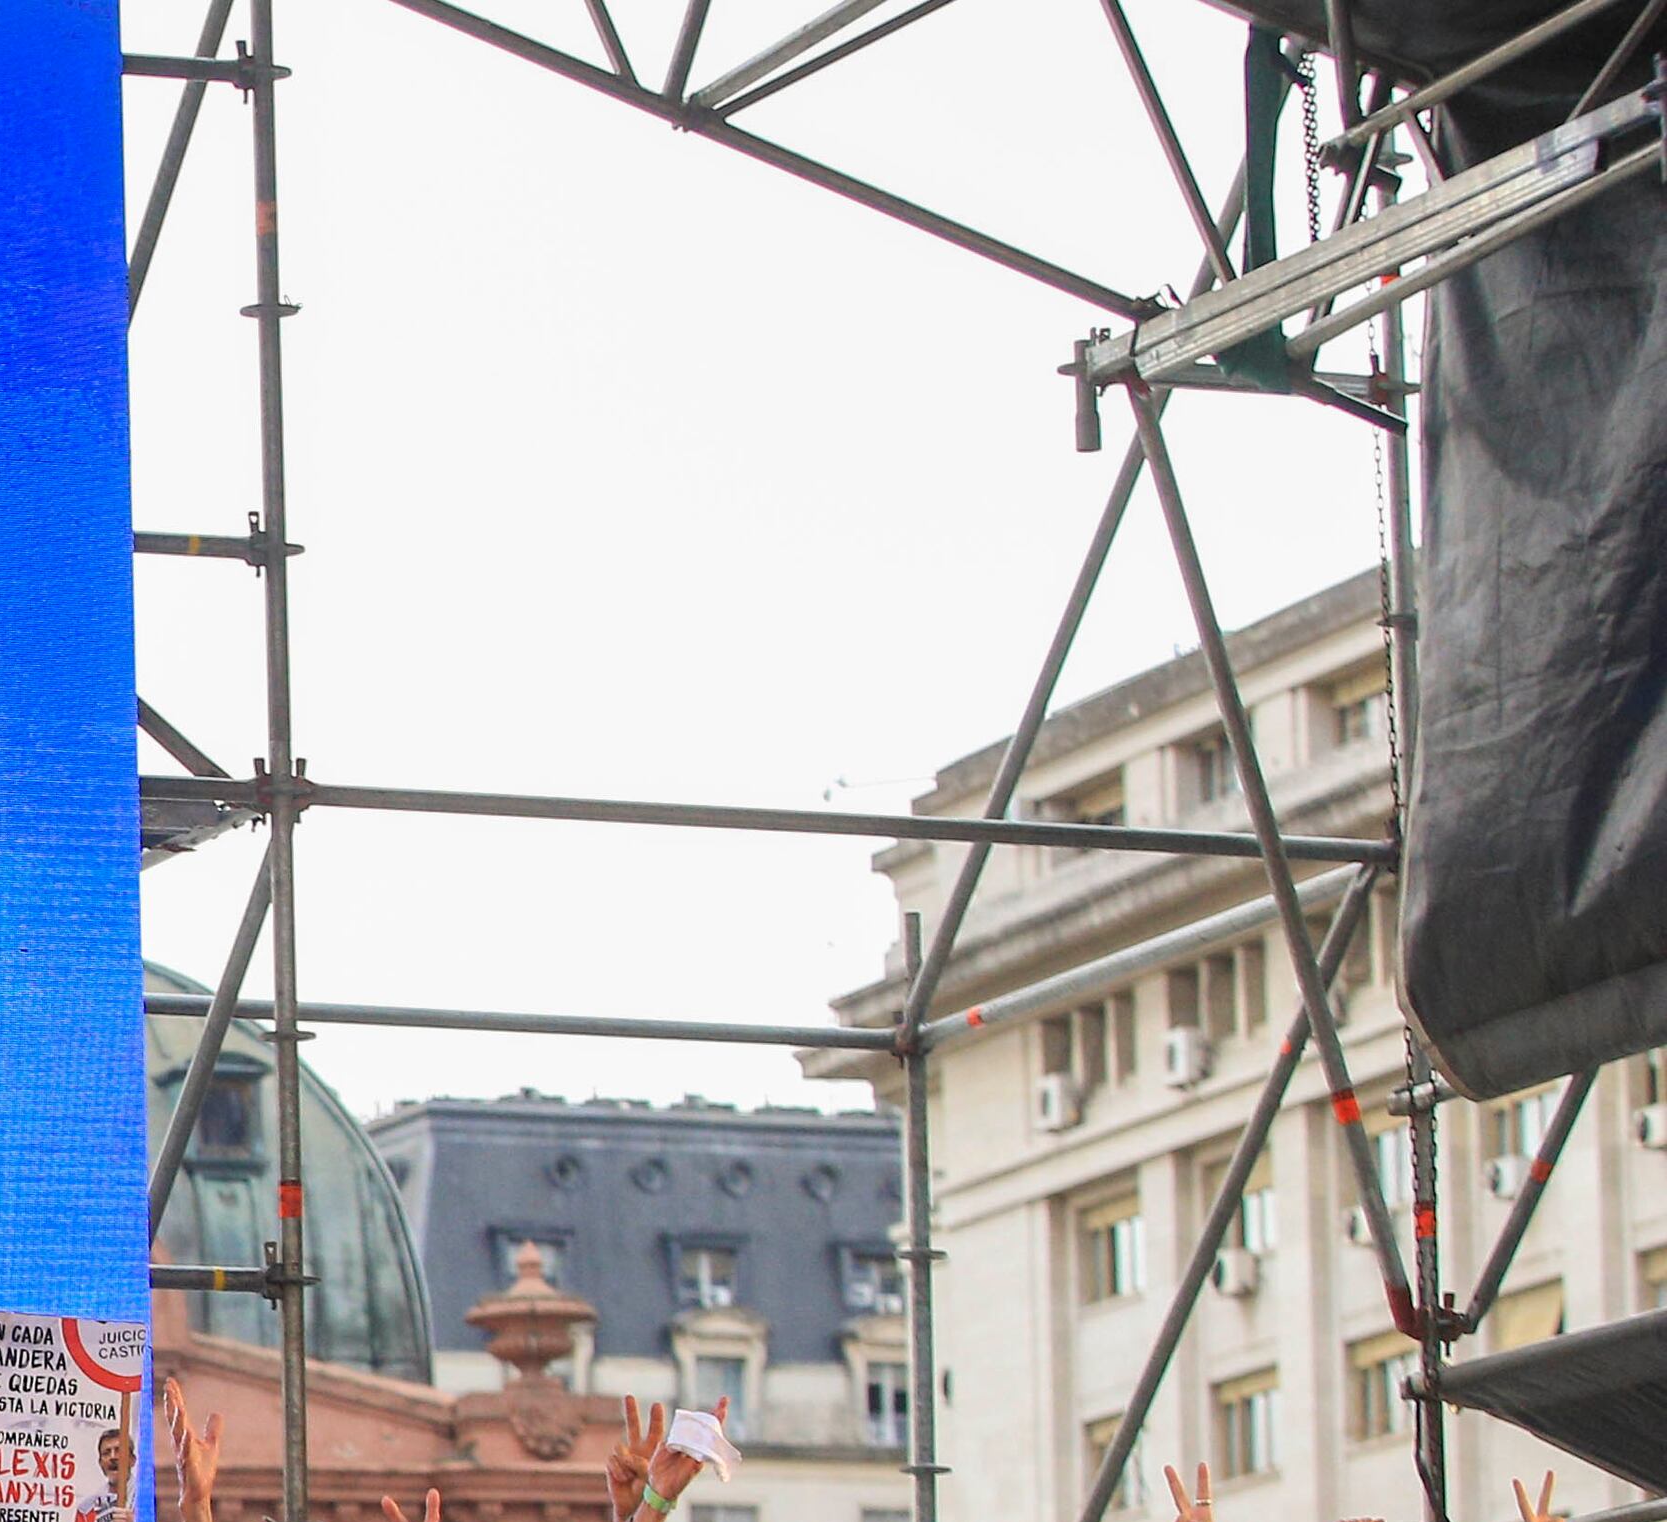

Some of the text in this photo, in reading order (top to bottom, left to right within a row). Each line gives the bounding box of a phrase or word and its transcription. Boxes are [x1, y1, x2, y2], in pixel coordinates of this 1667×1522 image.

[12, 1325, 54, 1345] CADA
[30, 1398, 48, 1415] LA
[55, 1400, 116, 1421] VICTORIA
